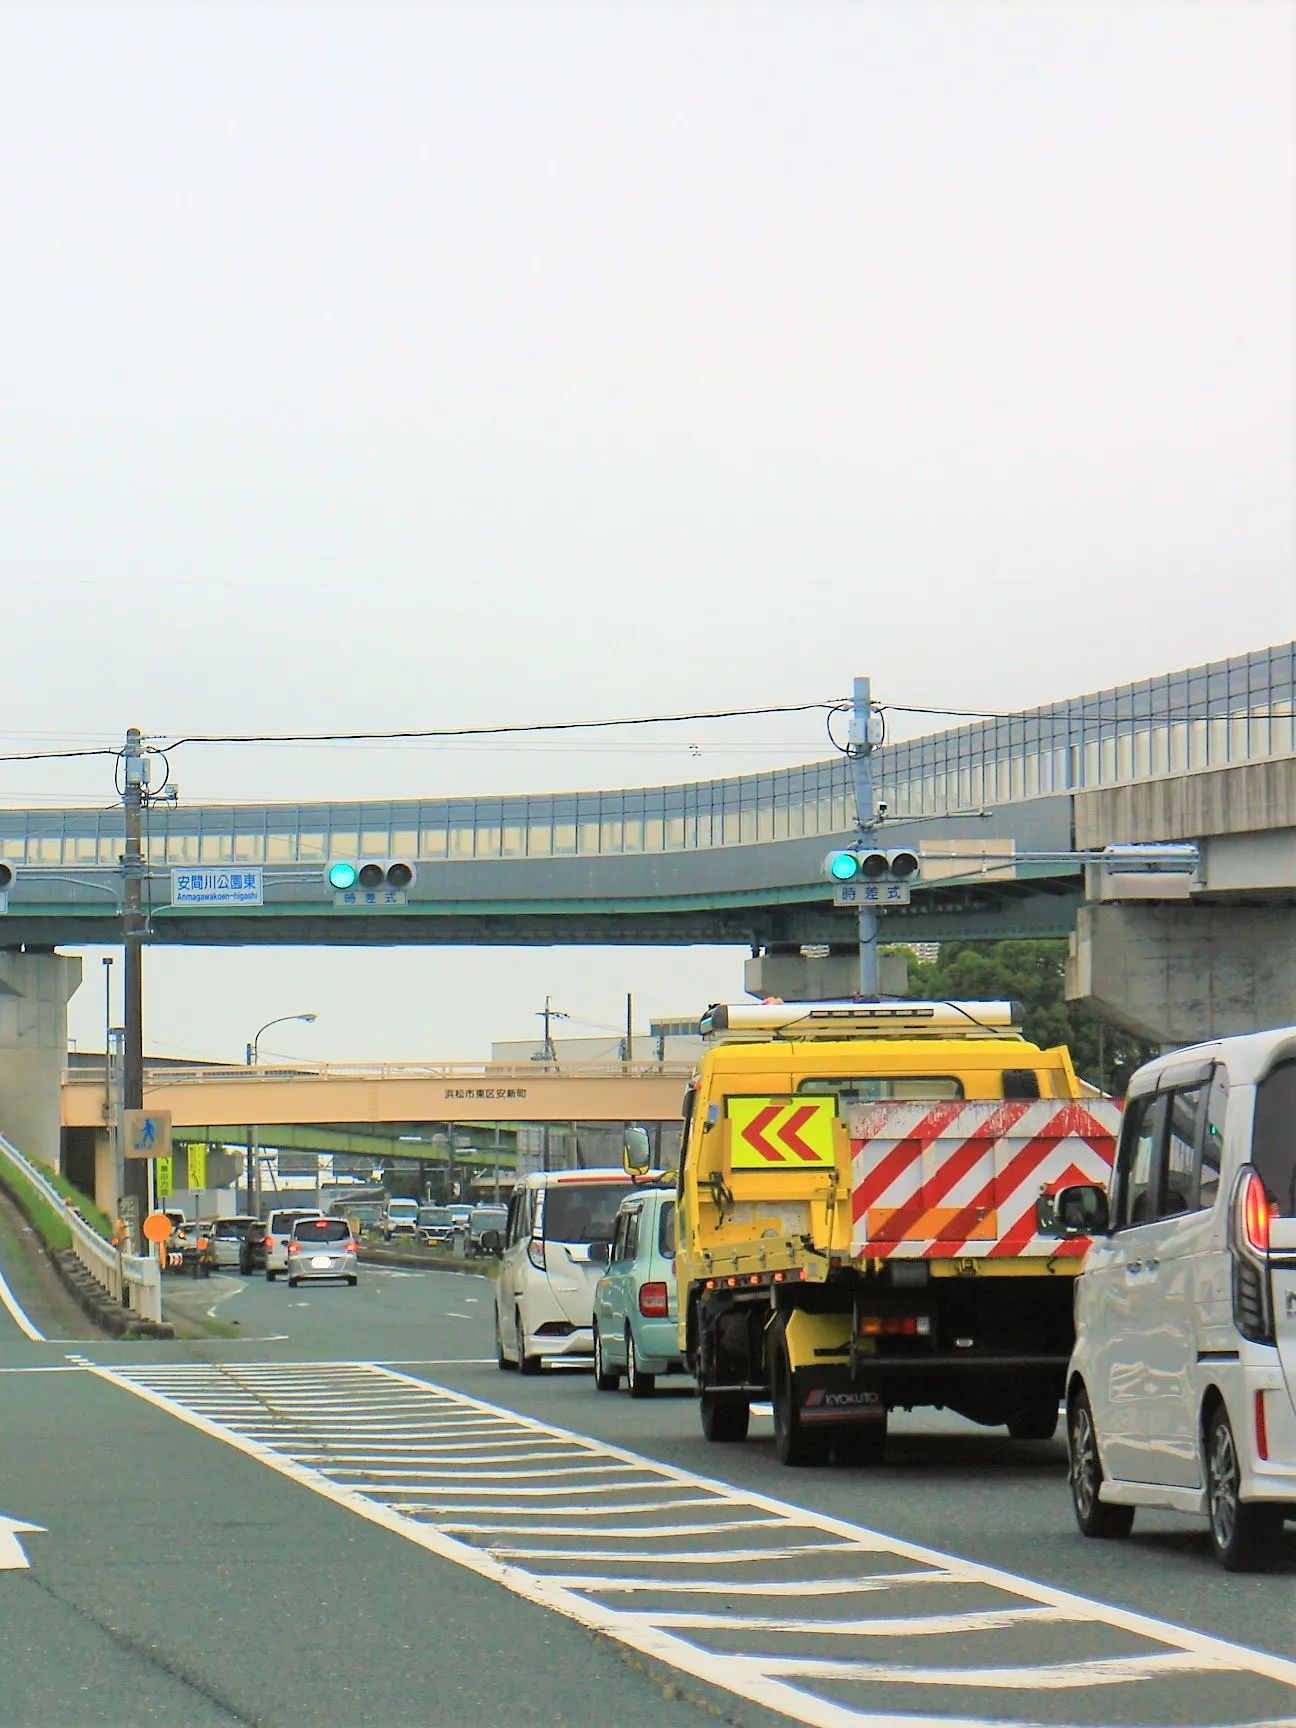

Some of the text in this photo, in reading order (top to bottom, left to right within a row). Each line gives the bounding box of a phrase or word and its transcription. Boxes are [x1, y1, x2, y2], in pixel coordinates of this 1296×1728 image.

[177, 874, 256, 890] 安間川公園東
[344, 890, 396, 904] 時差式
[842, 886, 901, 900] 時差式
[825, 1392, 879, 1405] KYOKUTO
